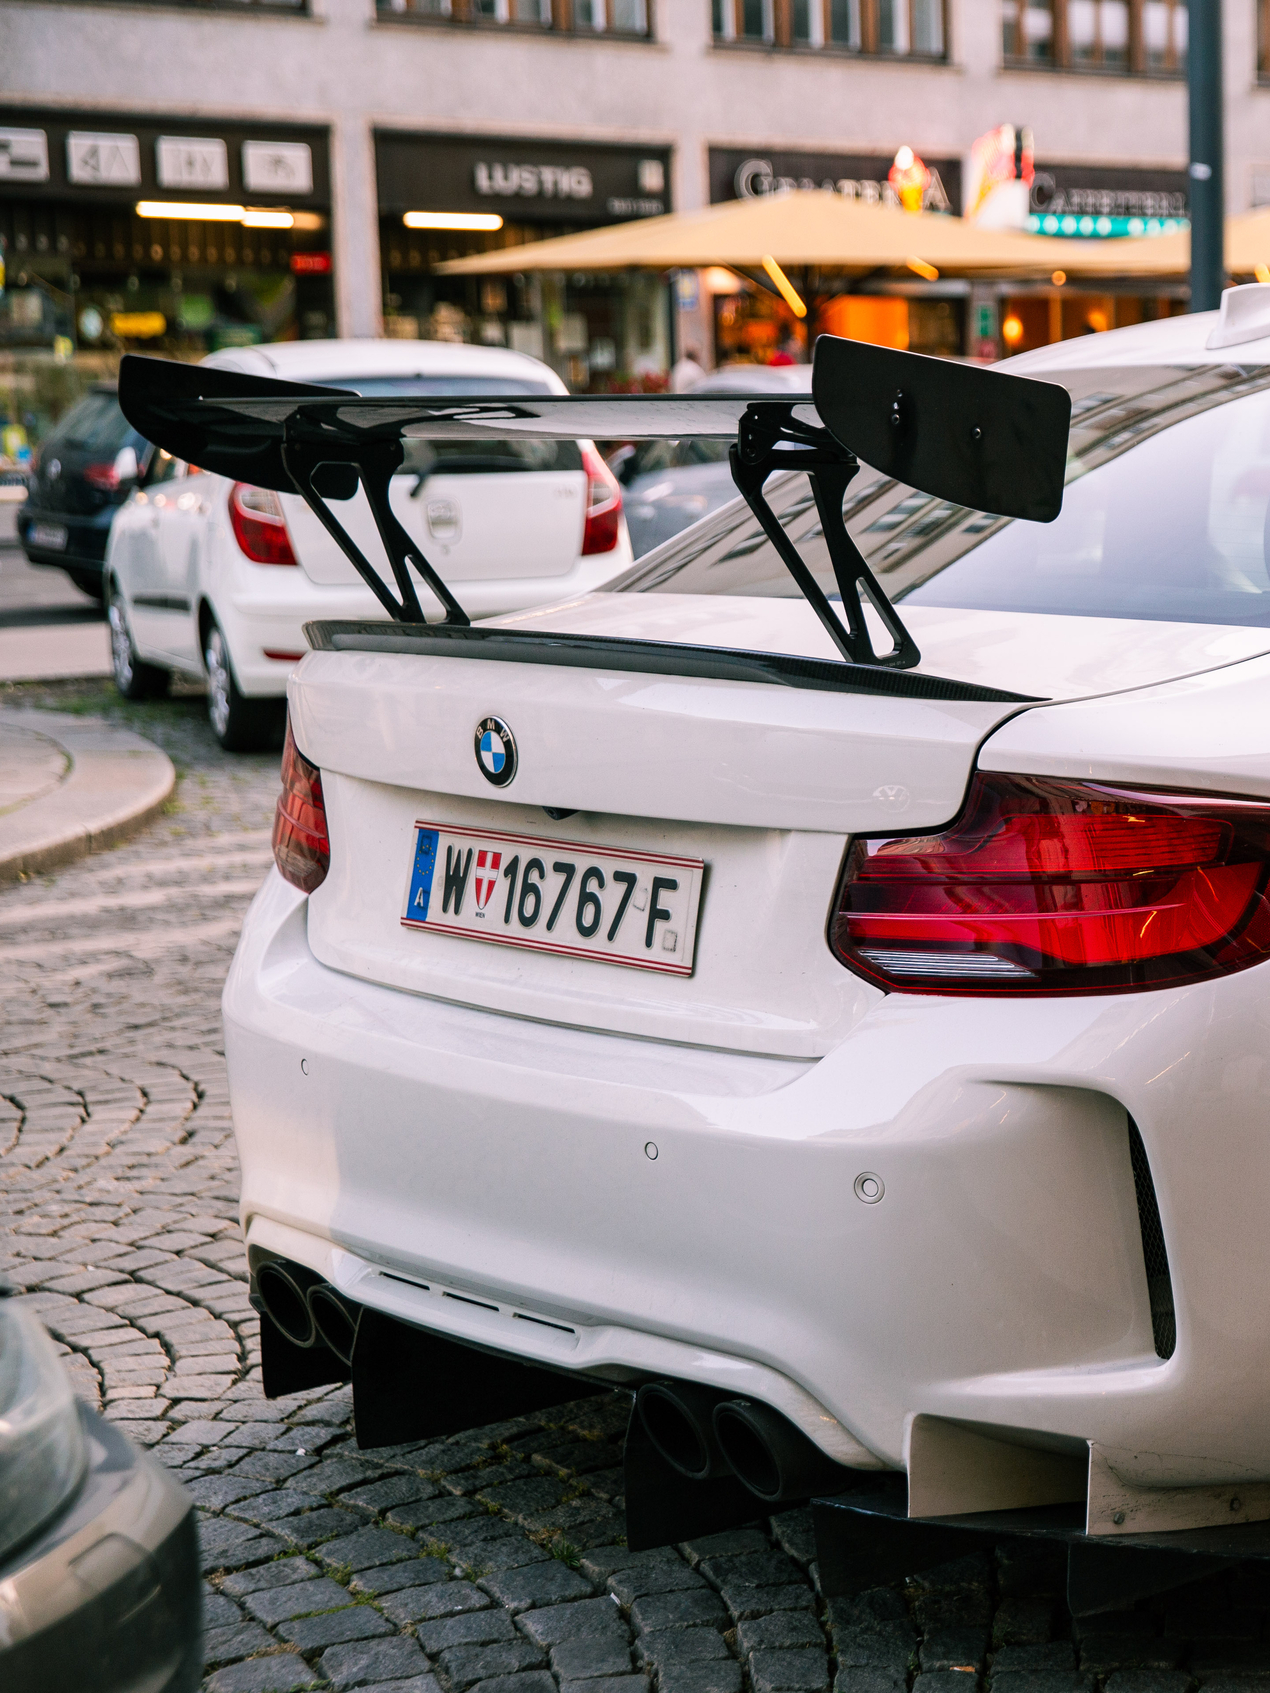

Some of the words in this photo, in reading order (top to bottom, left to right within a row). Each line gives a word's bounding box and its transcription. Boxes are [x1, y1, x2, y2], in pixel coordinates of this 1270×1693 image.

[474, 162, 594, 198] LUSTIG
[476, 718, 510, 742] BMW
[414, 887, 424, 907] A
